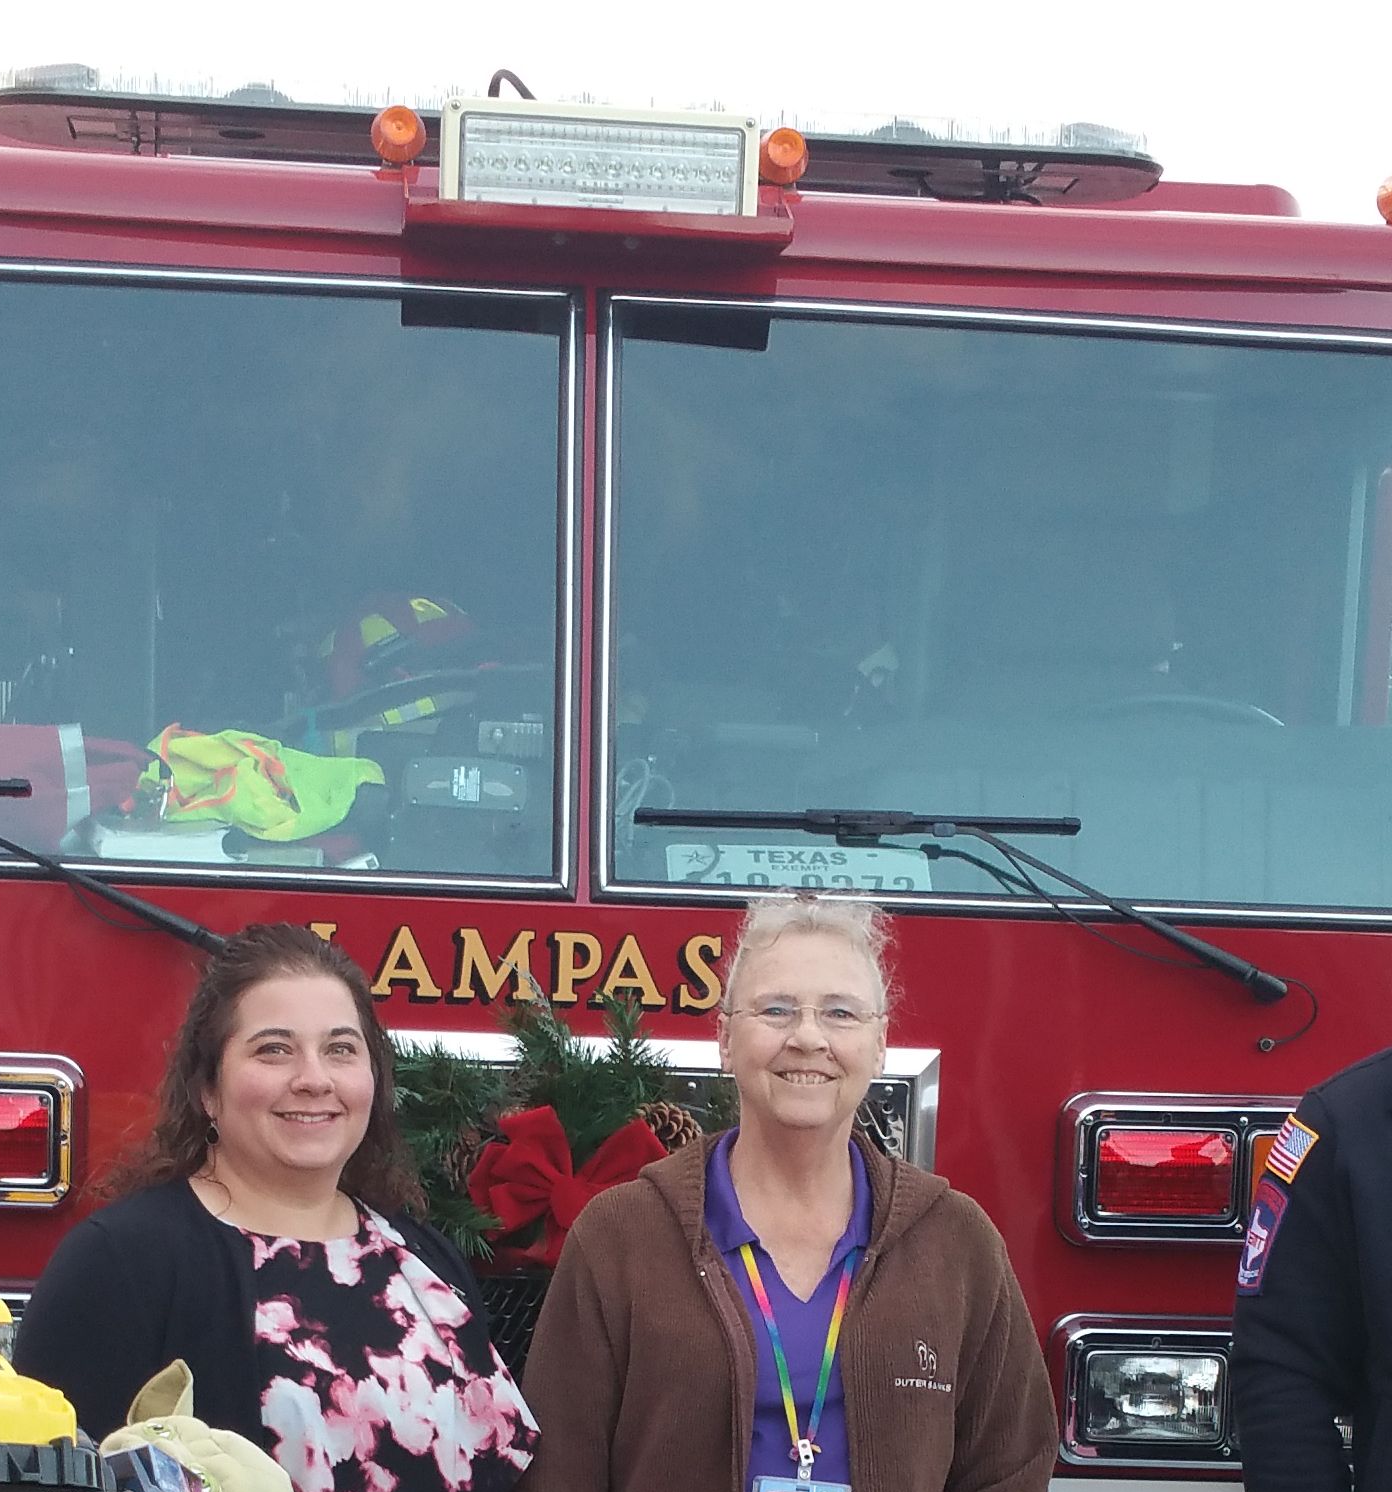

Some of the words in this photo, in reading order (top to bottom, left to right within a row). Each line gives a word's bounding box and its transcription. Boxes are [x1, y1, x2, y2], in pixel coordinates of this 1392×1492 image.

[747, 850, 848, 865] TEXAS
[771, 864, 831, 873] EXEMPT
[310, 922, 724, 1011] AMPAS
